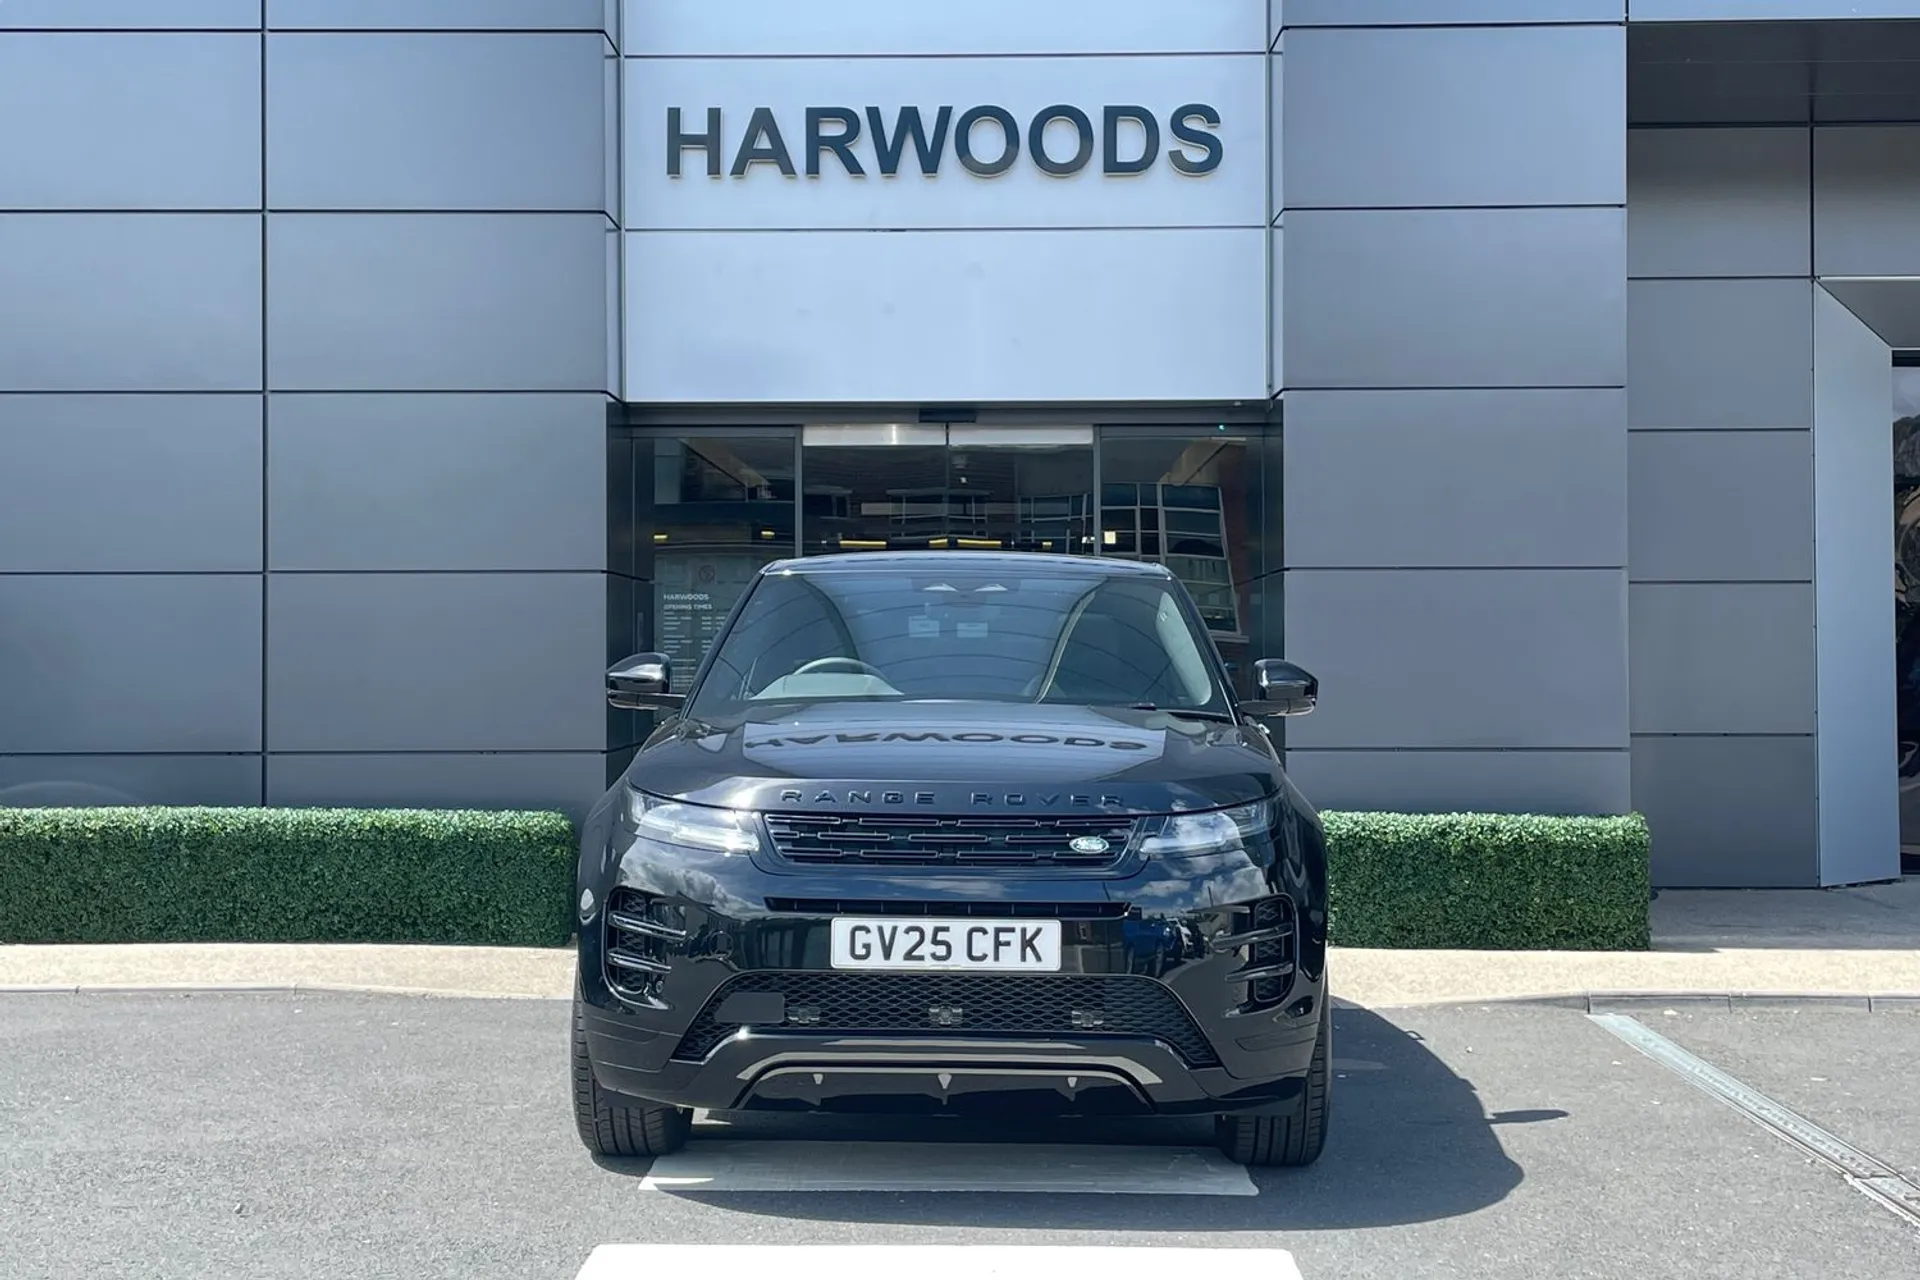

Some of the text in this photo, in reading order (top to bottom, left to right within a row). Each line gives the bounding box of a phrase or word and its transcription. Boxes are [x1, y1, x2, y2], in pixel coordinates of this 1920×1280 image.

[667, 103, 1224, 177] HARWOODS
[780, 789, 1124, 807] RANGE ROVER
[849, 925, 1043, 962] GV25 CFK
